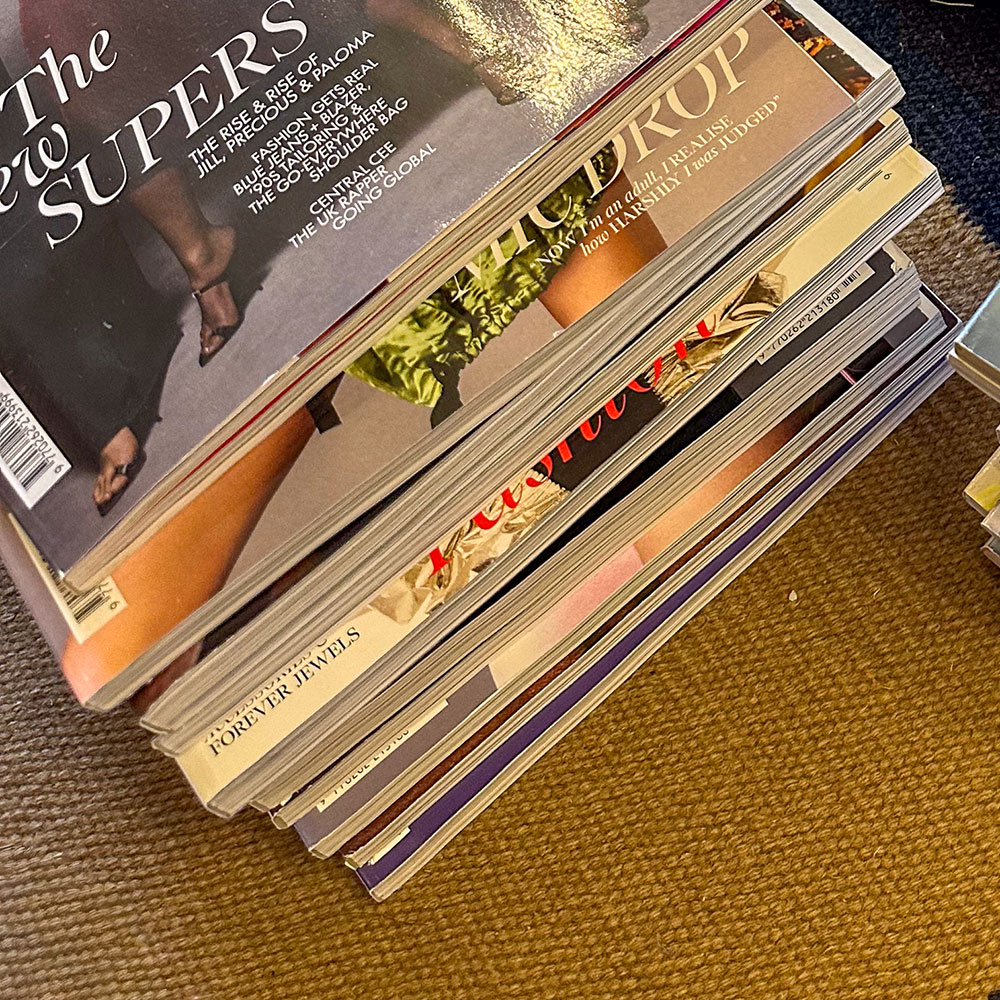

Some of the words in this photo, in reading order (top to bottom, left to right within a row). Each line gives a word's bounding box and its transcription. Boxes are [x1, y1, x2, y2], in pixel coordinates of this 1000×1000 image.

[0, 29, 118, 136] The
[188, 136, 219, 164] THE
[219, 110, 252, 142] RISE
[253, 100, 266, 114] &
[265, 72, 298, 102] RISE
[297, 52, 319, 76] OF
[199, 152, 226, 179] JILL,
[225, 91, 298, 153] PRECIOUS
[299, 79, 314, 93] &
[312, 29, 375, 82] PALOMA
[250, 112, 313, 164] FASHION
[311, 85, 346, 114] GETS
[343, 58, 379, 87] REAL
[279, 114, 349, 173] TAILORING
[350, 102, 364, 116] &
[583, 27, 750, 199] DROP
[233, 164, 267, 196] BLUE
[267, 130, 309, 171] JEANS
[319, 83, 372, 125] BLAZER,
[248, 190, 277, 215] THE
[276, 96, 390, 193] GO-EVERYWHERE
[308, 125, 379, 183] SHOULDER
[377, 97, 409, 127] BAG
[309, 165, 370, 215] CENTRAL
[368, 141, 398, 166] CEE
[332, 189, 383, 231] GOING
[383, 143, 437, 189] GLOBAL
[581, 216, 604, 238] I'm
[605, 199, 623, 219] an
[624, 170, 663, 203] adult,
[669, 114, 734, 168] REALISE
[288, 222, 318, 249] THE
[317, 207, 340, 227] UK
[337, 164, 388, 210] RAPPER
[579, 230, 610, 258] how
[608, 177, 682, 235] HARSHLY
[692, 148, 719, 170] was
[209, 684, 292, 757] FOREVER
[295, 626, 361, 688] JEWELS
